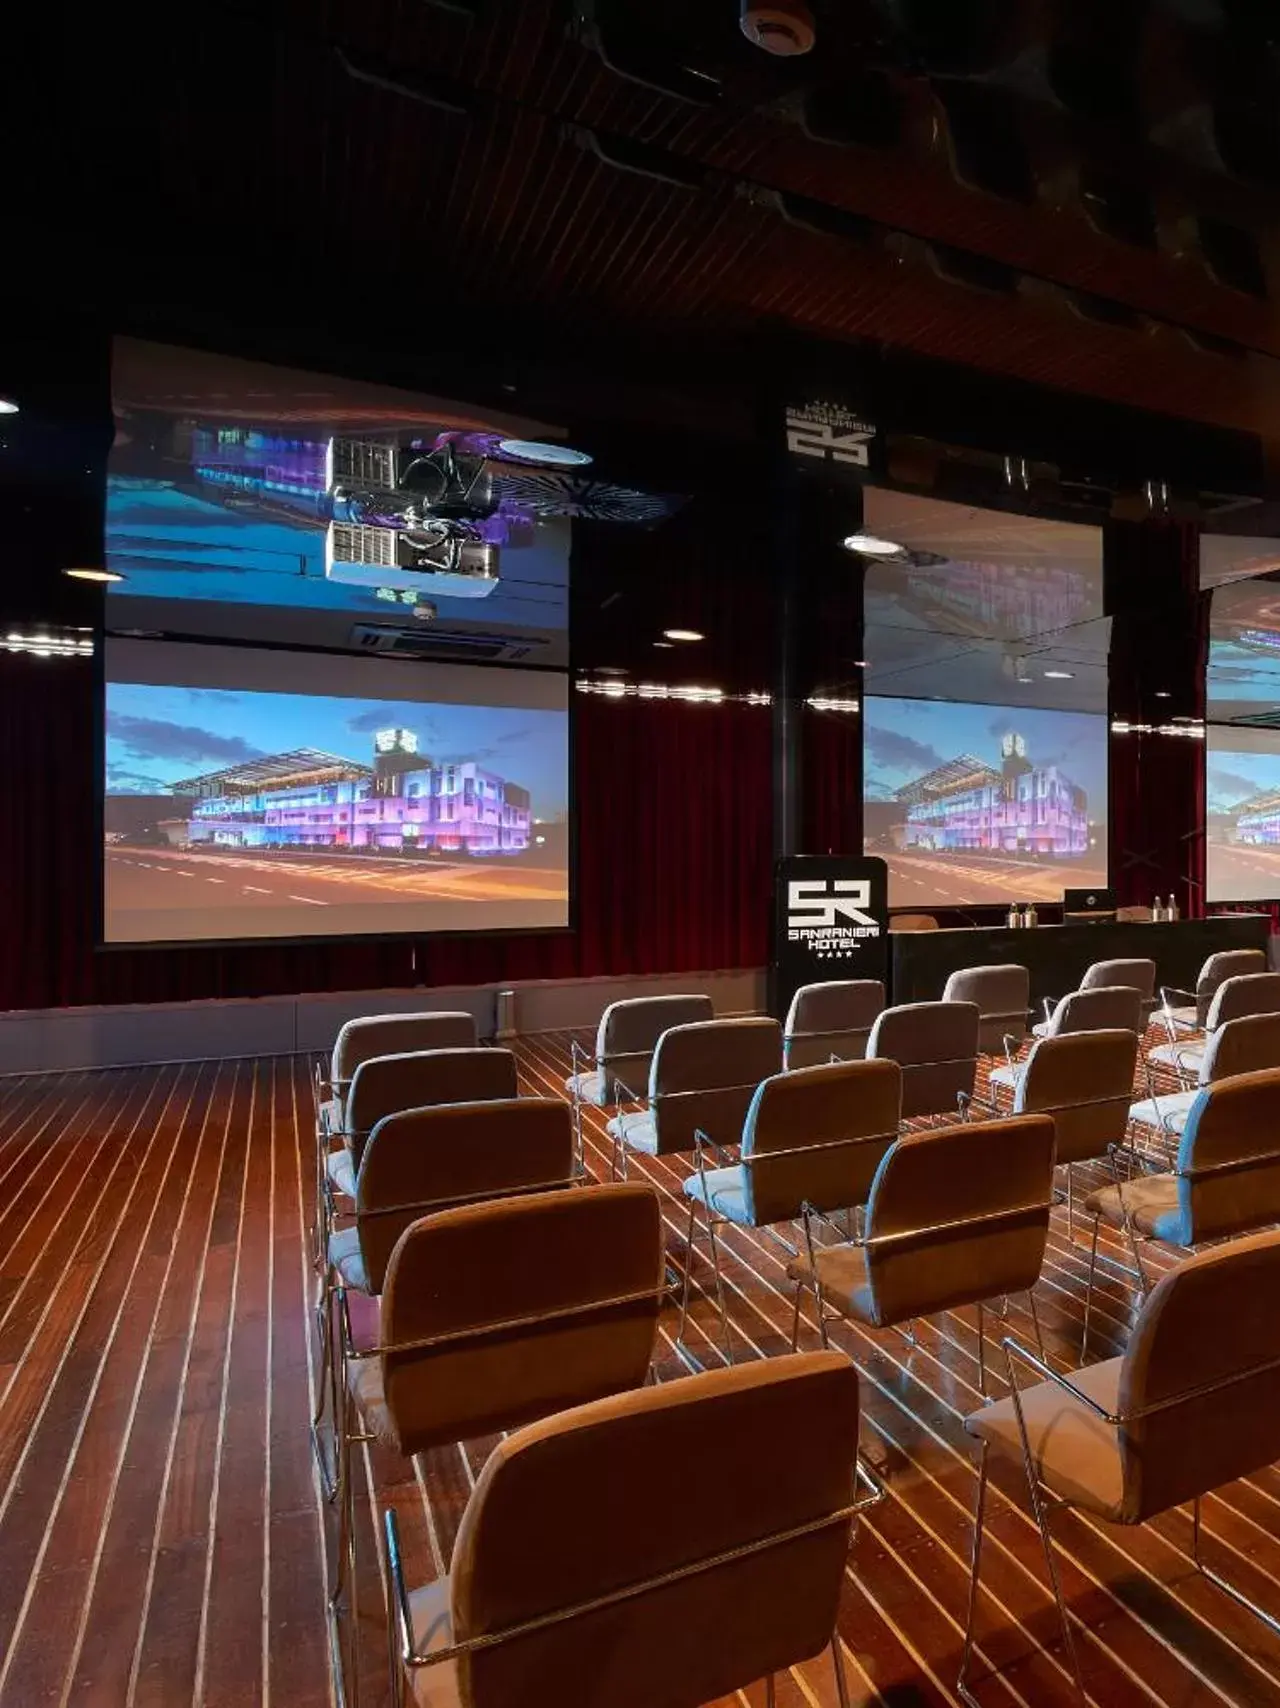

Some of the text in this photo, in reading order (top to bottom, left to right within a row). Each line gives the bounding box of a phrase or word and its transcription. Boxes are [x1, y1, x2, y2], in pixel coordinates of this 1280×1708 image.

[788, 880, 879, 927] SR
[788, 927, 880, 941] SANRANIERI
[808, 938, 861, 950] HOTEL
